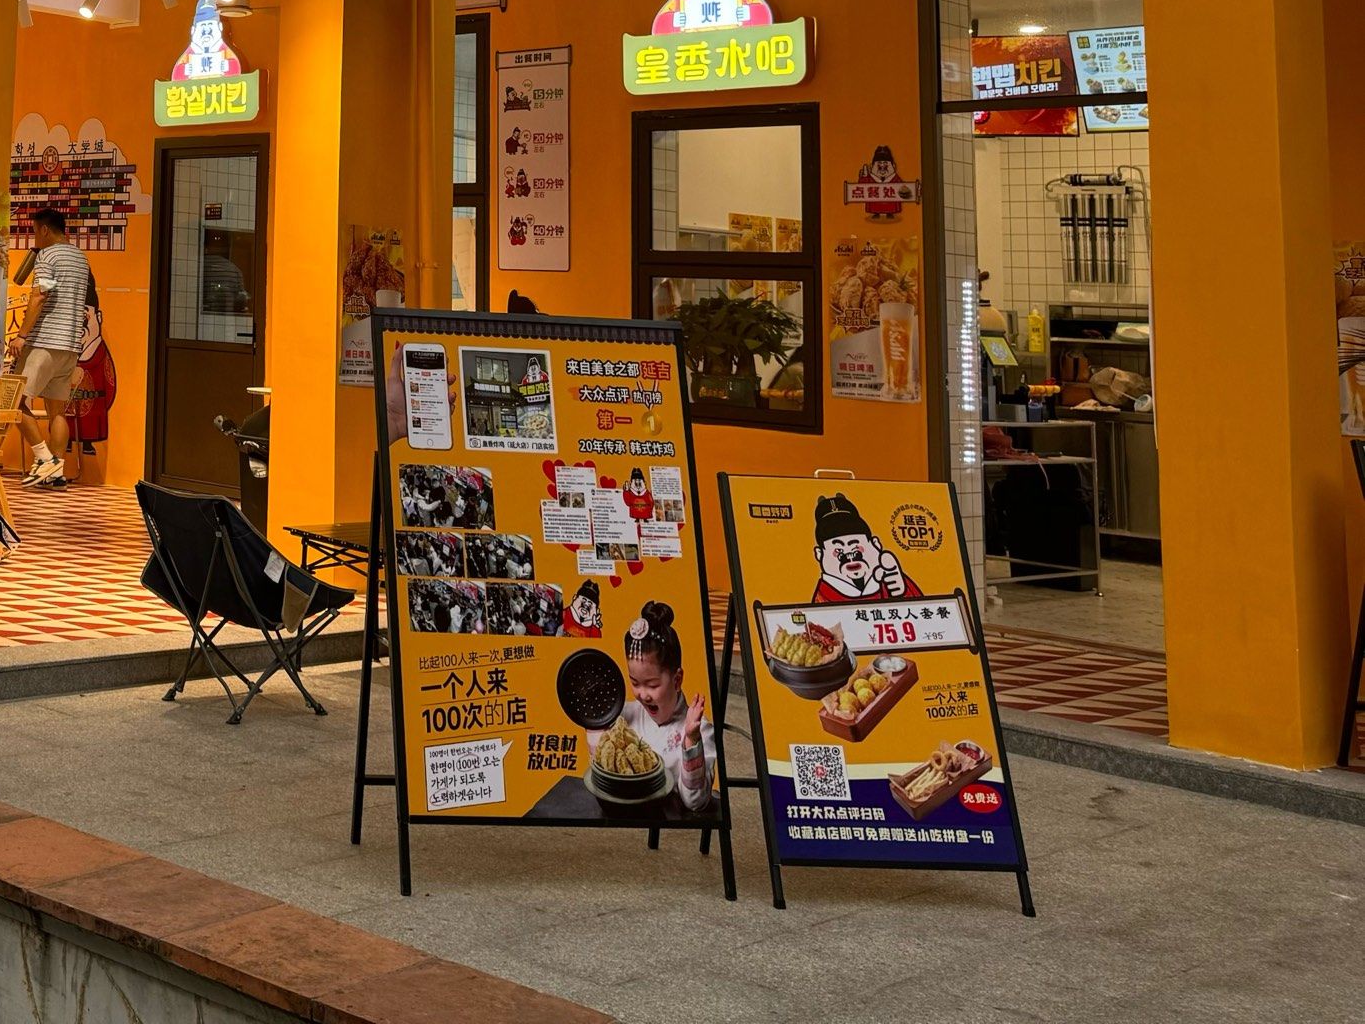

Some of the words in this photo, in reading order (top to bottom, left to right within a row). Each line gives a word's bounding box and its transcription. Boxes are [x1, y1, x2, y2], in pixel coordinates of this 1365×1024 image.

[701, 2, 721, 23] 炸
[514, 51, 553, 64] 出餐时间
[635, 35, 794, 85] 皇香水吧
[166, 81, 248, 119] 황실치킨
[533, 88, 564, 100] 15分钟
[533, 133, 564, 144] 20分钟
[533, 178, 564, 190] 30分钟
[851, 186, 897, 200] 点餐处
[533, 225, 564, 237] 40分钟
[566, 359, 640, 378] 来自美食之都
[641, 361, 671, 380] 延吉
[579, 385, 631, 404] 大众点评
[632, 389, 663, 405] 热门榜
[596, 409, 633, 430] 第一
[579, 439, 626, 454] 20年传承
[629, 441, 675, 456] 韩式炸鸡
[903, 515, 927, 526] 延吉
[898, 526, 935, 540] TOP1
[855, 607, 951, 622] 超值双人套餐
[420, 667, 508, 700] 一个人来
[923, 690, 968, 705] 一个人来
[421, 697, 527, 734] 100次的店
[925, 703, 979, 719] 100次的店
[528, 734, 577, 752] 好食材
[430, 759, 456, 775] 한명이
[458, 757, 481, 770] 100번
[482, 755, 500, 768] 오는
[527, 753, 577, 771] 放心吃
[431, 774, 458, 789] 가게가
[460, 771, 487, 785] 되도록
[962, 792, 999, 805] 免费送
[786, 805, 885, 821] 打开大众点评扫码
[788, 825, 995, 844] 收藏本店即可免费赠送小吃拼盘一份
